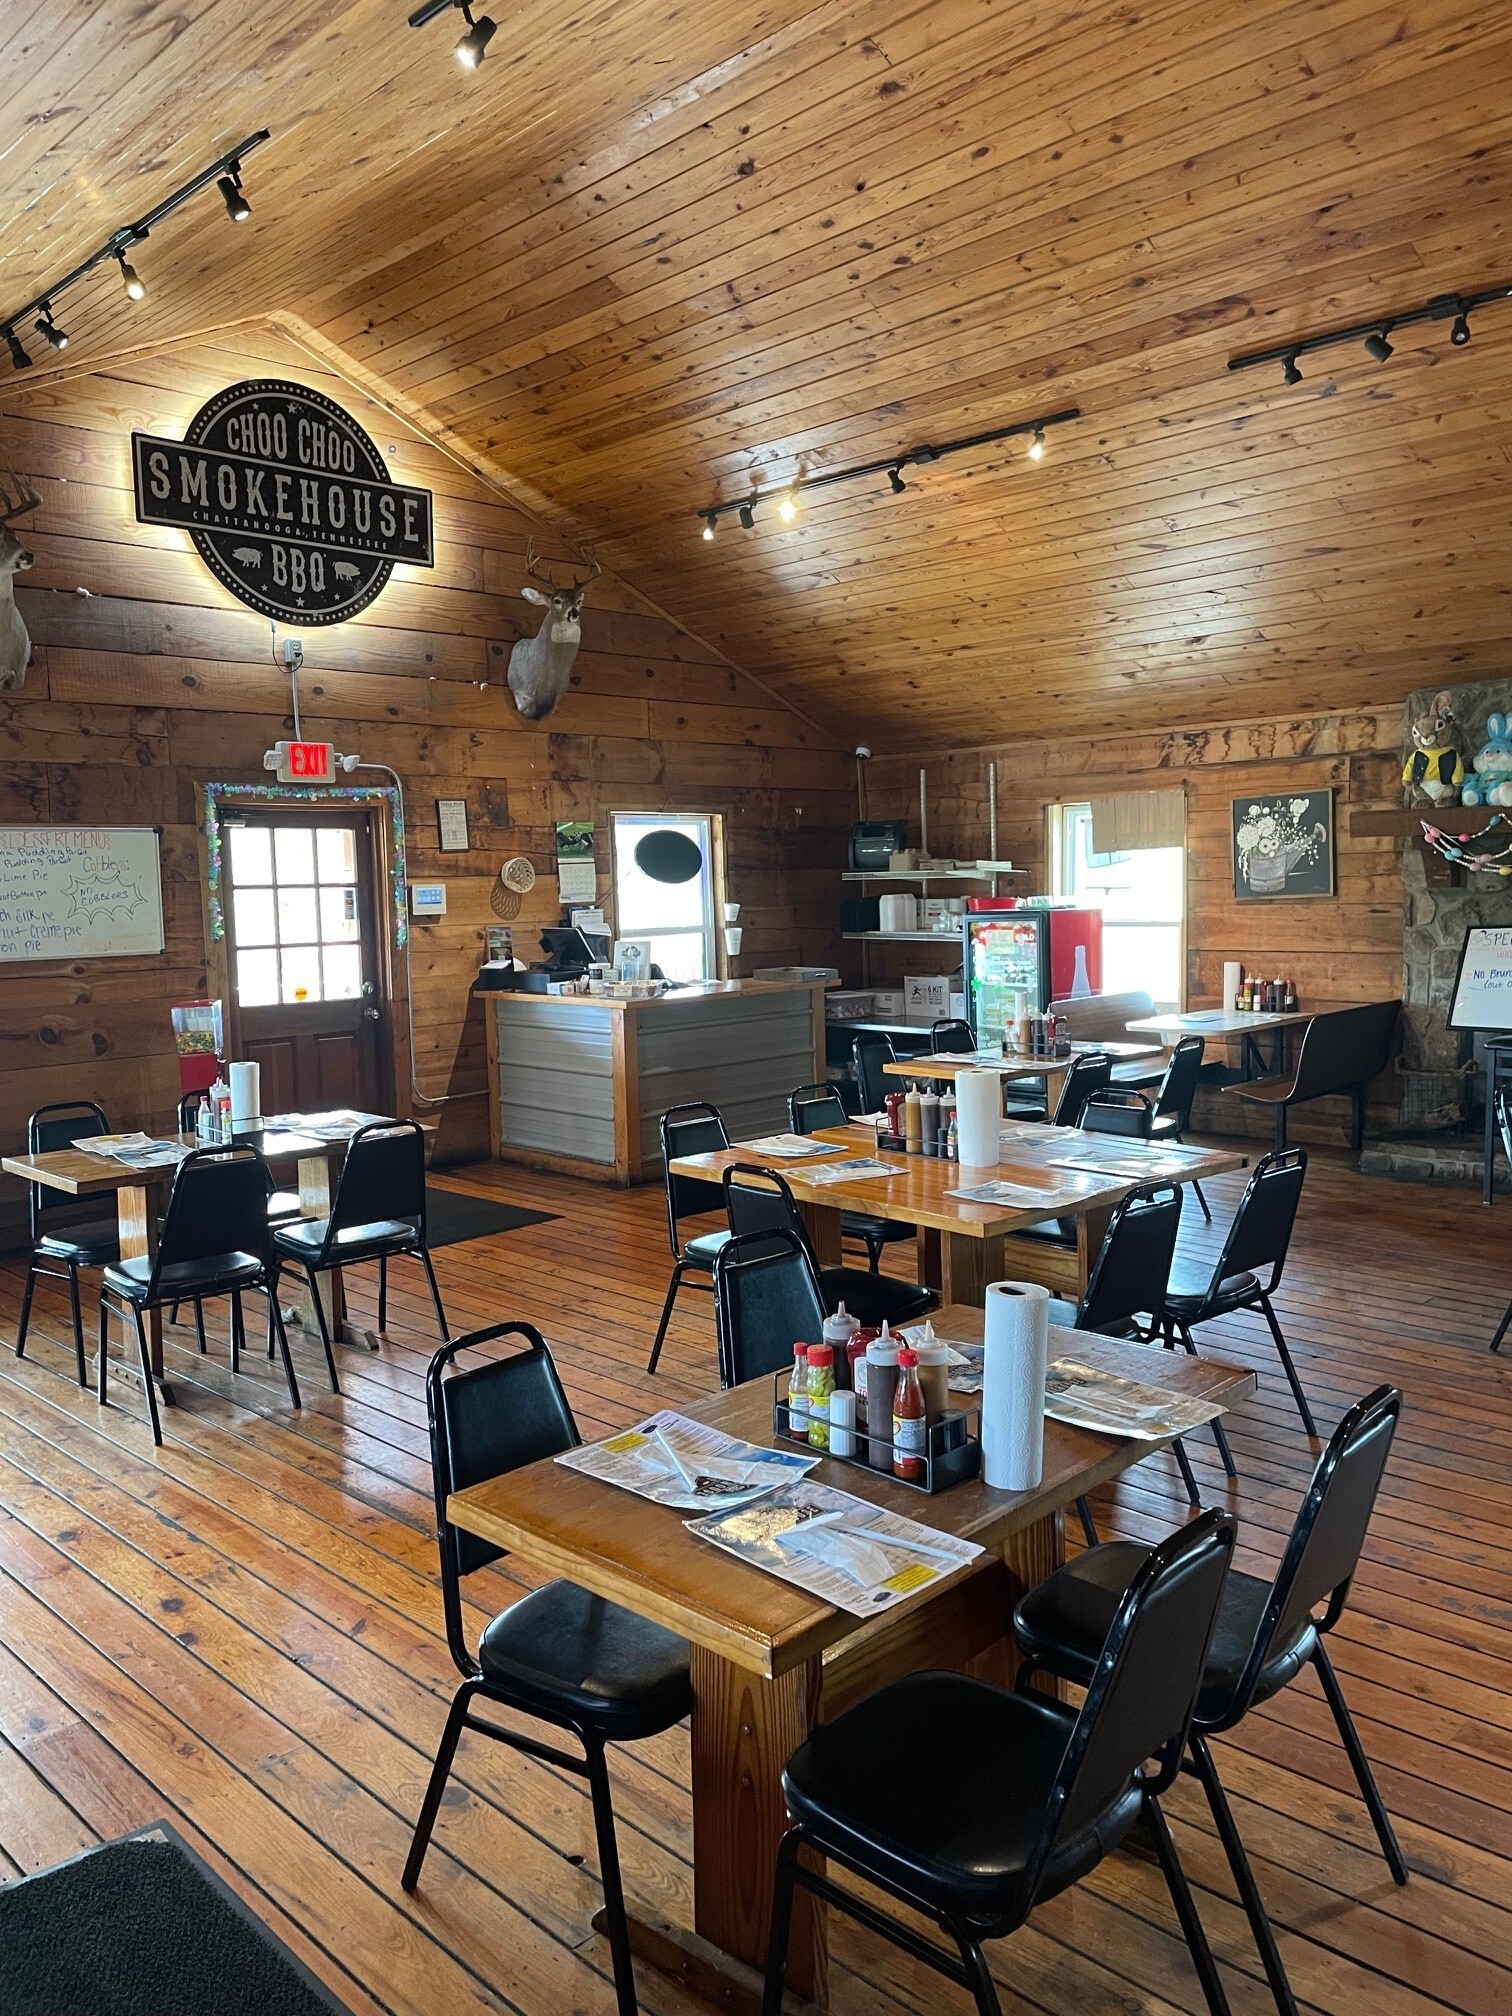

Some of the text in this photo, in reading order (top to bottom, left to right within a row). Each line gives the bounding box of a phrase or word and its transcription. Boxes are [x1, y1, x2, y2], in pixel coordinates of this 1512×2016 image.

[226, 412, 355, 472] CHOO CHOO
[148, 452, 420, 542] SMOKEHOUSE
[312, 530, 387, 550] TENNESSEE
[271, 543, 326, 593] BBQ
[289, 744, 328, 776] EXIT
[74, 831, 106, 849] MENU
[17, 847, 65, 858] Pudding
[4, 857, 43, 868] Pudding
[32, 869, 49, 880] Pie
[1482, 932, 1512, 946] SPE
